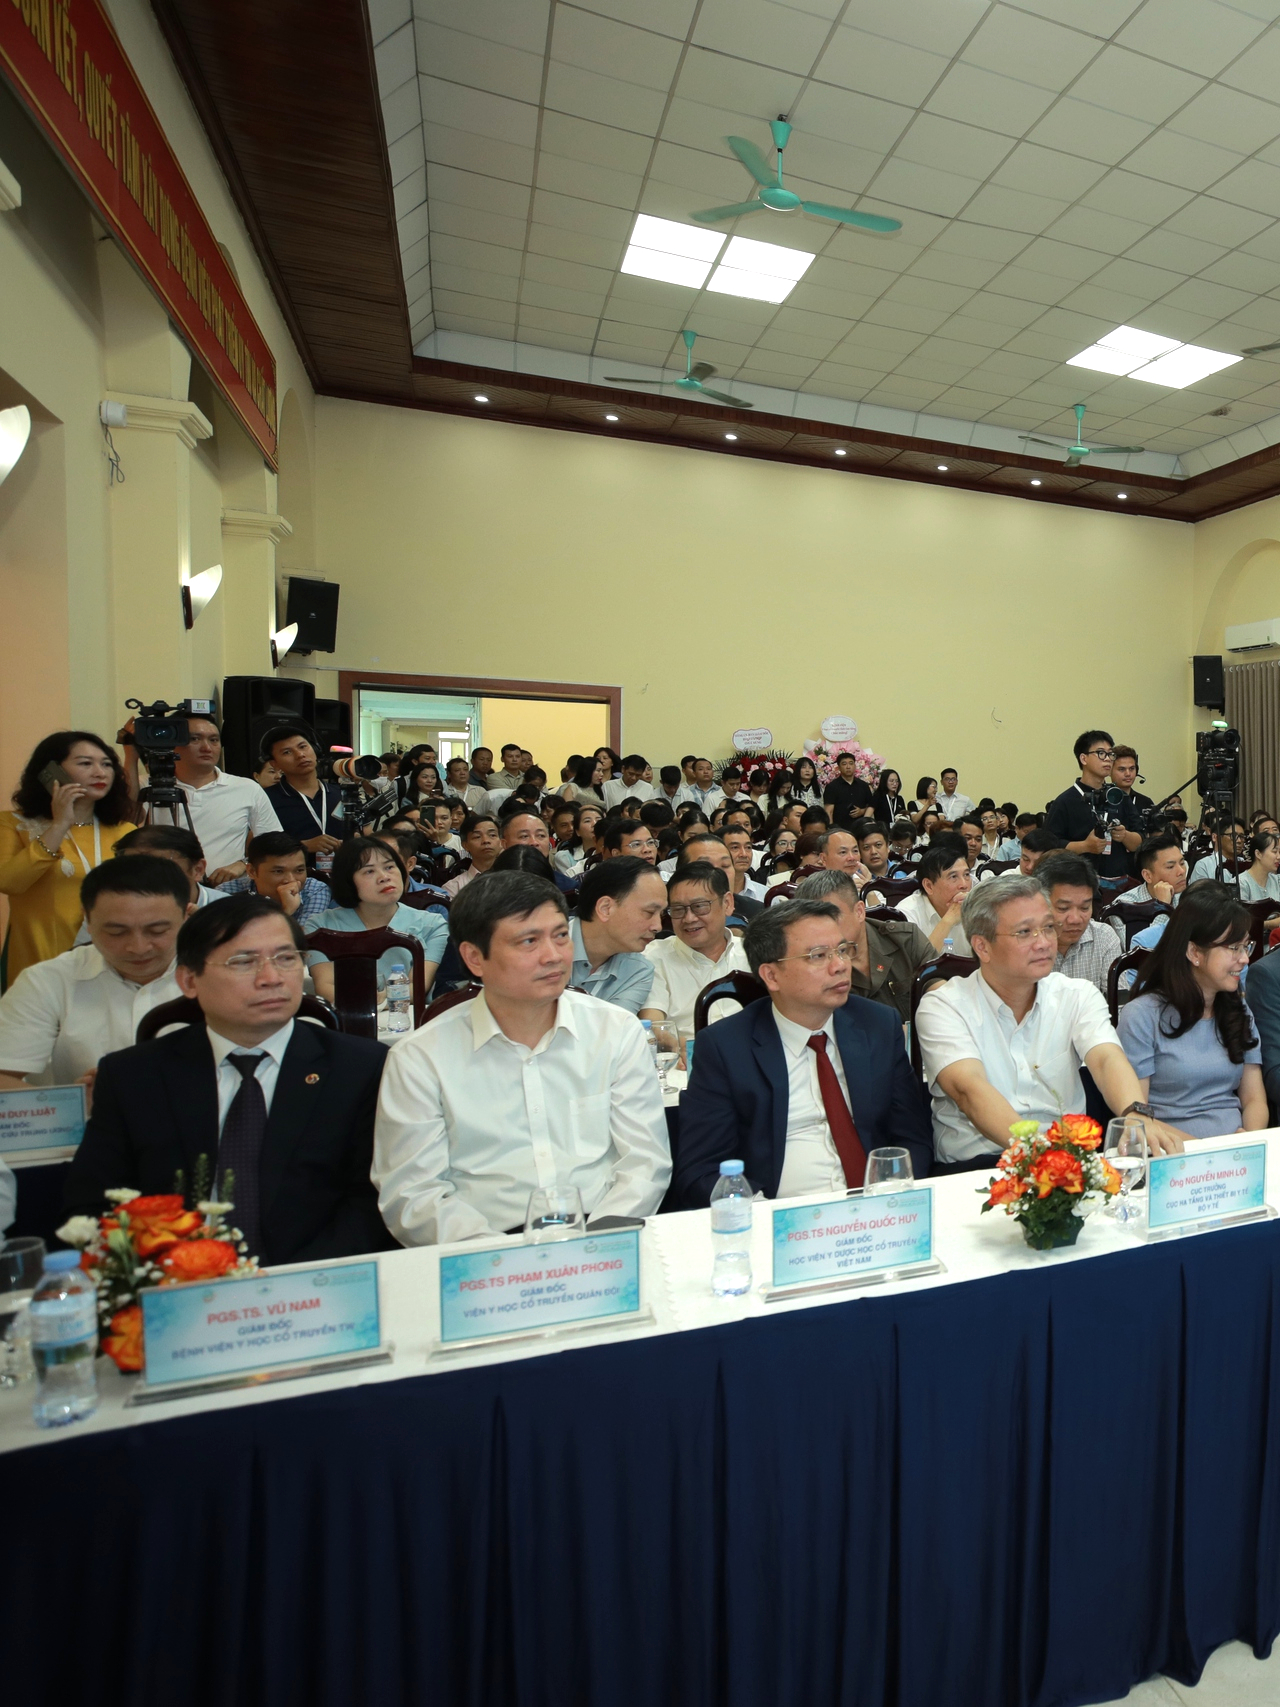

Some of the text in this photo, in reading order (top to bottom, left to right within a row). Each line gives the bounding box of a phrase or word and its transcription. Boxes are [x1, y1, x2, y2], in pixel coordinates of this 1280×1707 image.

[1169, 1166, 1247, 1188] Ông NGUYỄN MINH LỢI
[1166, 1201, 1178, 1209] CỤC
[1205, 1193, 1212, 1201] VÀ
[1213, 1190, 1229, 1200] THIẾT
[1242, 1187, 1249, 1195] TẾ
[1190, 1187, 1203, 1196] CỤC
[1198, 1203, 1206, 1213] BỘ
[1212, 1201, 1219, 1209] TẾ
[787, 1213, 918, 1242] PGS.TS NGUYỄN QUỐC HUY
[789, 1257, 805, 1266] HỌC
[807, 1252, 826, 1263] VIỆN
[834, 1248, 856, 1259] DƯỢC
[857, 1245, 873, 1255] HỌC
[875, 1241, 886, 1251] CỔ
[888, 1236, 917, 1249] TRUYỀN
[835, 1234, 873, 1247] GIÁM ĐỐC
[837, 1255, 872, 1268] VIỆT NAM
[459, 1259, 623, 1292] PGS.TS PHẠM XUÂN PHONG
[520, 1282, 567, 1298] GIÁM ĐỐC
[207, 1298, 321, 1325] PGS.TS. VŨ NAM
[463, 1286, 620, 1319] VIỆN Y HỌC CỔ TRUYỀN QUÂN ĐỘI
[237, 1319, 293, 1336] GIÁM ĐỐC
[171, 1321, 355, 1361] BỆNH VIỆN Y HỌC CỔ TRUYỀN TW
